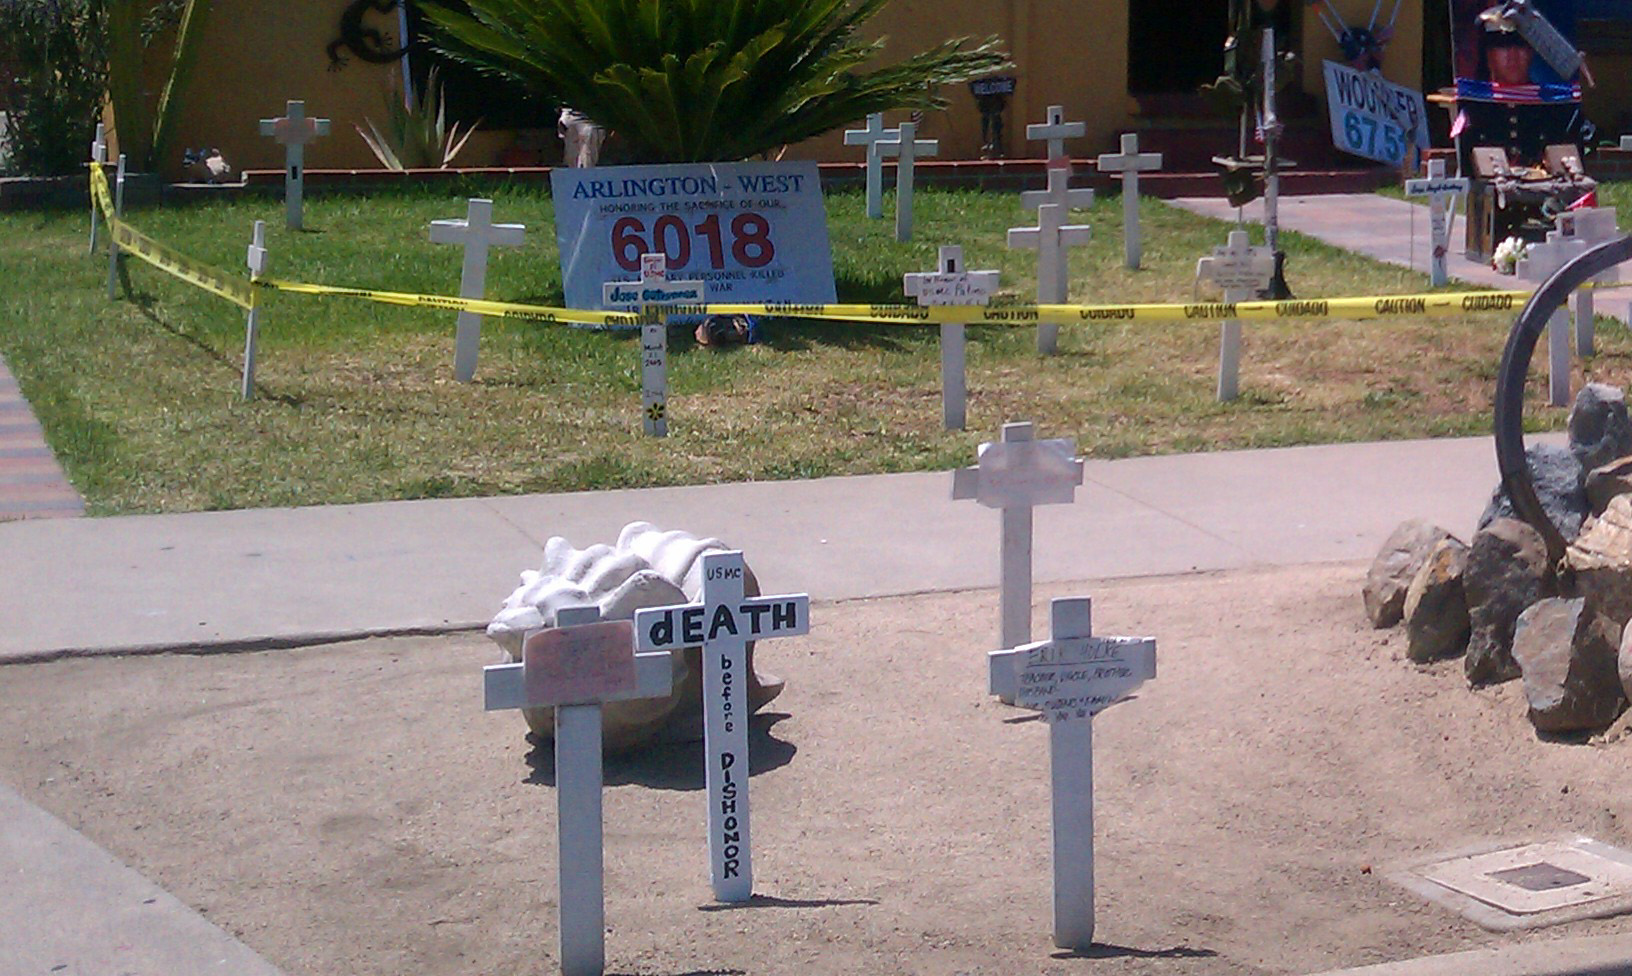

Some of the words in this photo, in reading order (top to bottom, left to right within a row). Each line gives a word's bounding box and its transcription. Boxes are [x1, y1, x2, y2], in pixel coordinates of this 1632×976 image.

[573, 176, 718, 199] ARLINGTON
[738, 174, 804, 193] WEST
[600, 202, 655, 213] HONORING
[661, 201, 680, 212] THE
[611, 212, 775, 272] 6018
[1276, 300, 1328, 317] CUIDADO
[1374, 298, 1426, 314] CAUTION
[1462, 293, 1513, 311] CUIDADO
[706, 566, 742, 581] USMC
[649, 602, 797, 647] dEATH
[721, 654, 733, 733] before
[720, 752, 740, 879] DISHONOR
